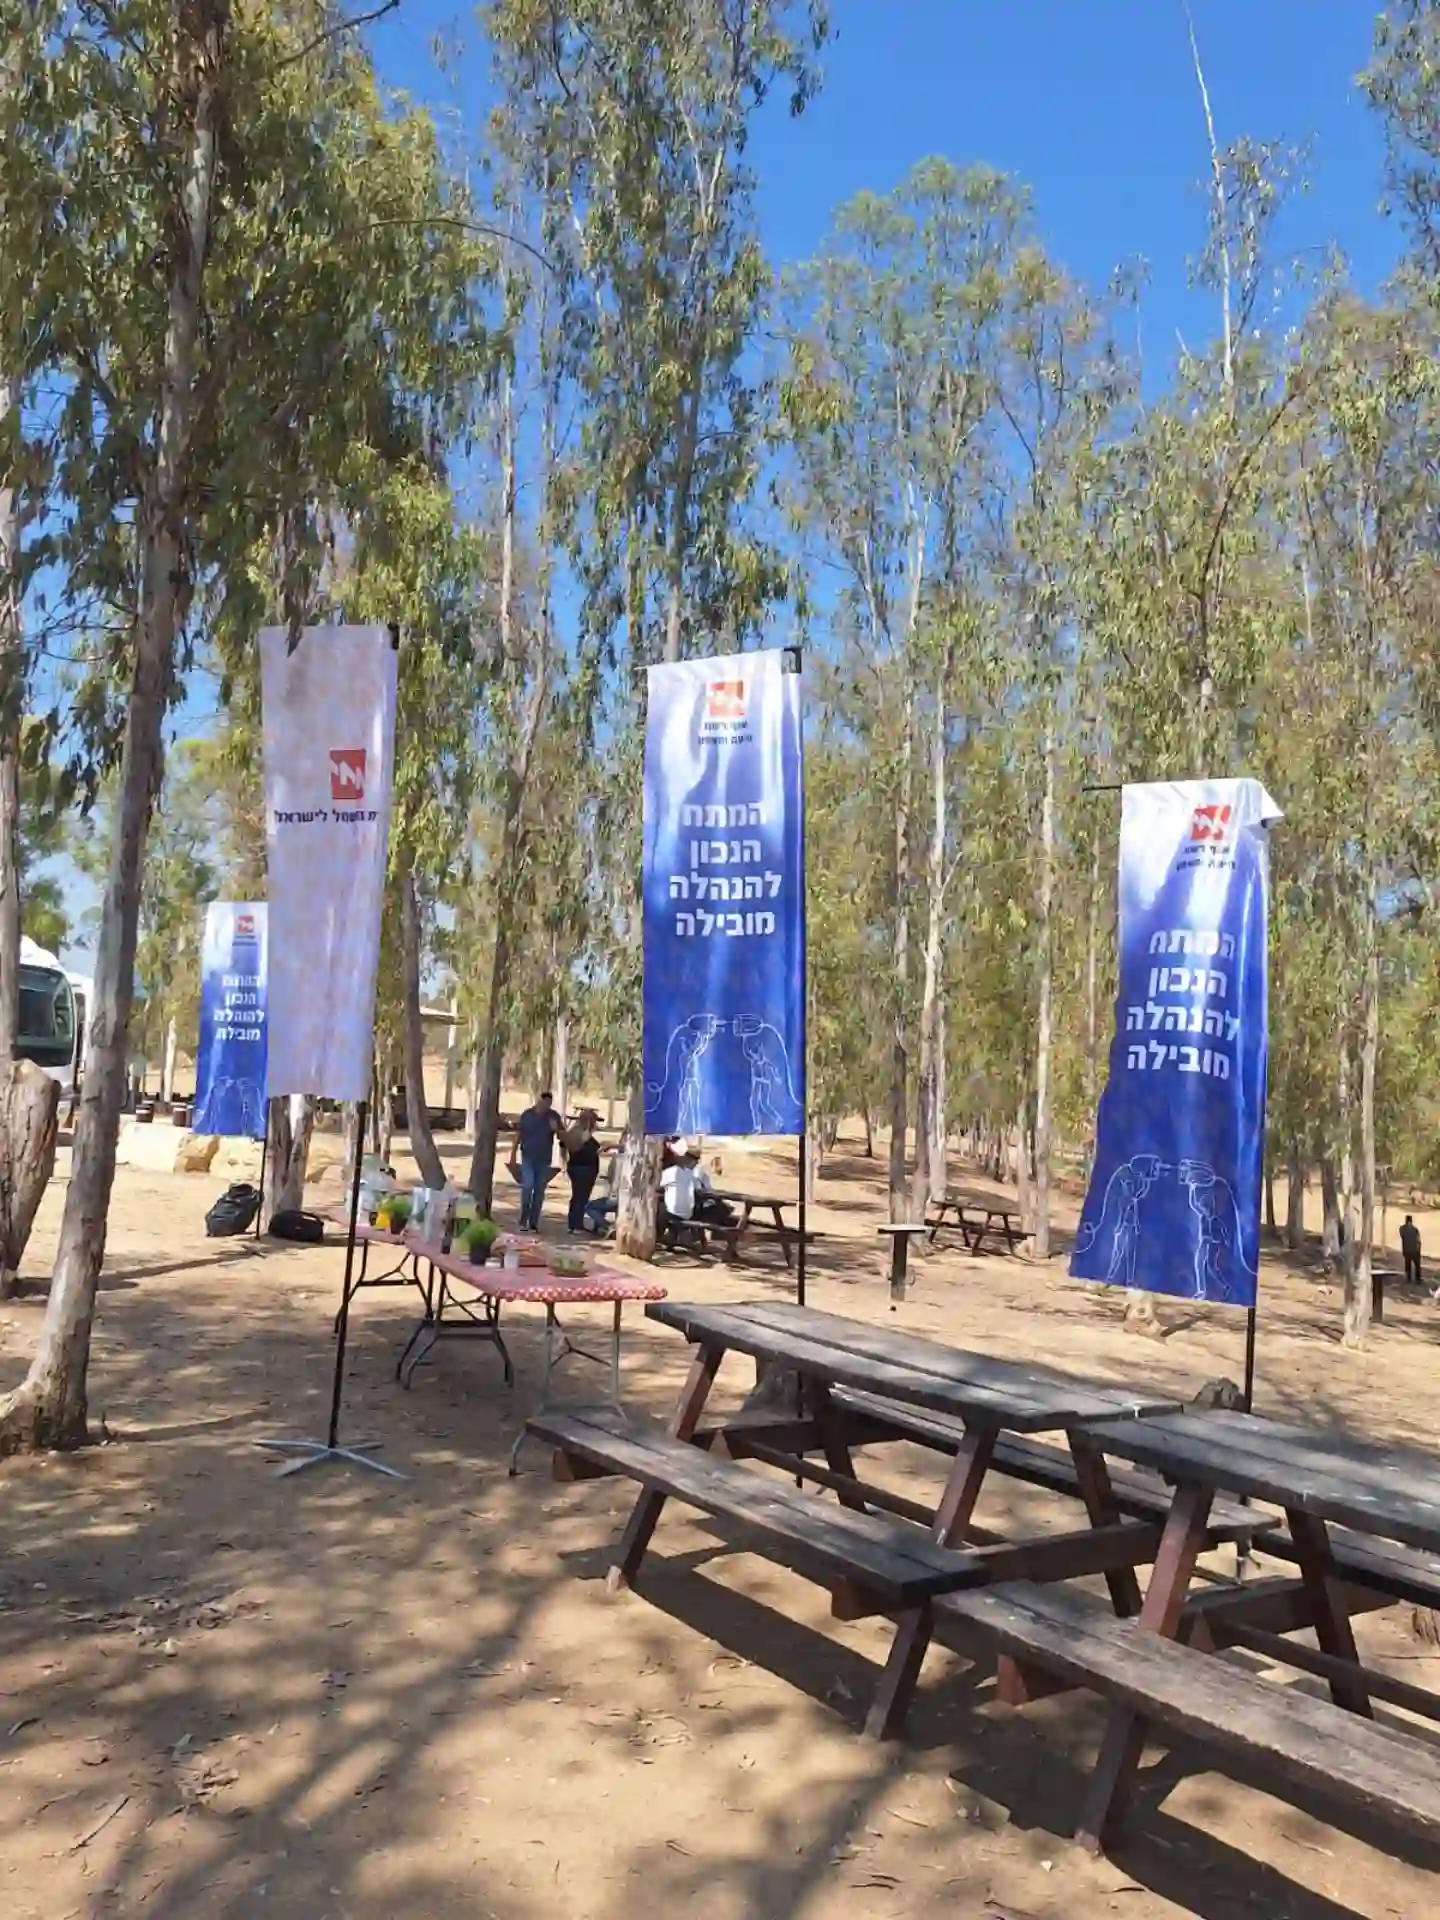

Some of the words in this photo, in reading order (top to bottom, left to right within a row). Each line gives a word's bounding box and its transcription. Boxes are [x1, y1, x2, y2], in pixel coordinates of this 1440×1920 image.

[274, 807, 328, 823] לישראל
[683, 802, 767, 828] המתח
[690, 838, 761, 869] הנכון
[669, 871, 782, 900] להנהלה
[675, 908, 775, 937] מובילה
[1149, 929, 1236, 961] המתח
[1148, 966, 1226, 998] הנכון
[1126, 1001, 1240, 1042] להנהלה
[1127, 1041, 1230, 1080] מובילה
